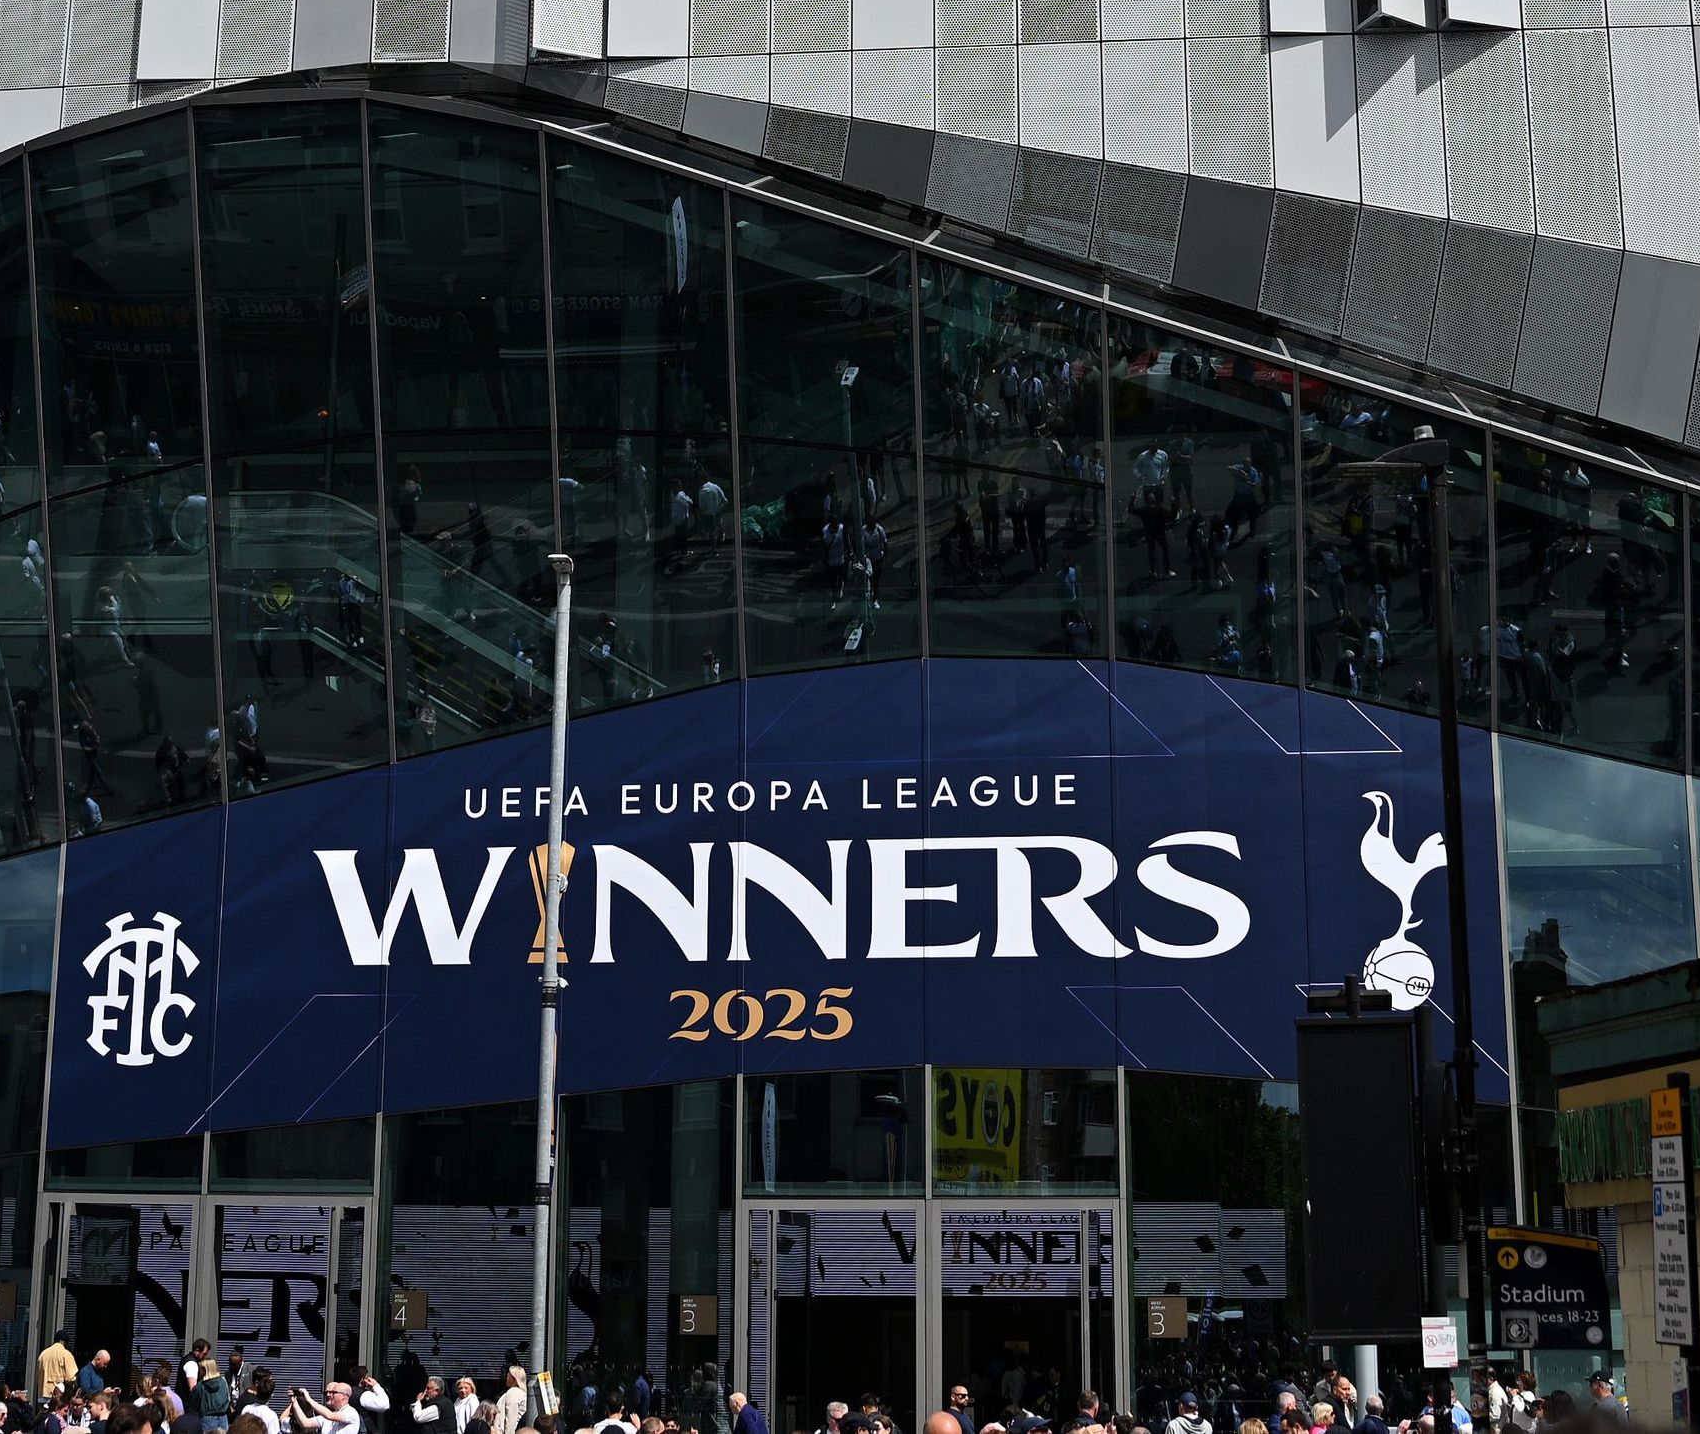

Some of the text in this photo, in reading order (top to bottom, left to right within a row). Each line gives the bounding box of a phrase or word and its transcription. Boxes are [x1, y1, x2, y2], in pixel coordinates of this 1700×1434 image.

[465, 773, 1078, 819] UEFA EUROPA LEAGUE
[668, 986, 854, 1042] 2025
[1501, 1283, 1585, 1303] Stadium
[394, 1305, 407, 1326] 4
[682, 1310, 695, 1332] 3
[1151, 1312, 1165, 1335] 3
[1567, 1310, 1599, 1323] 18-23
